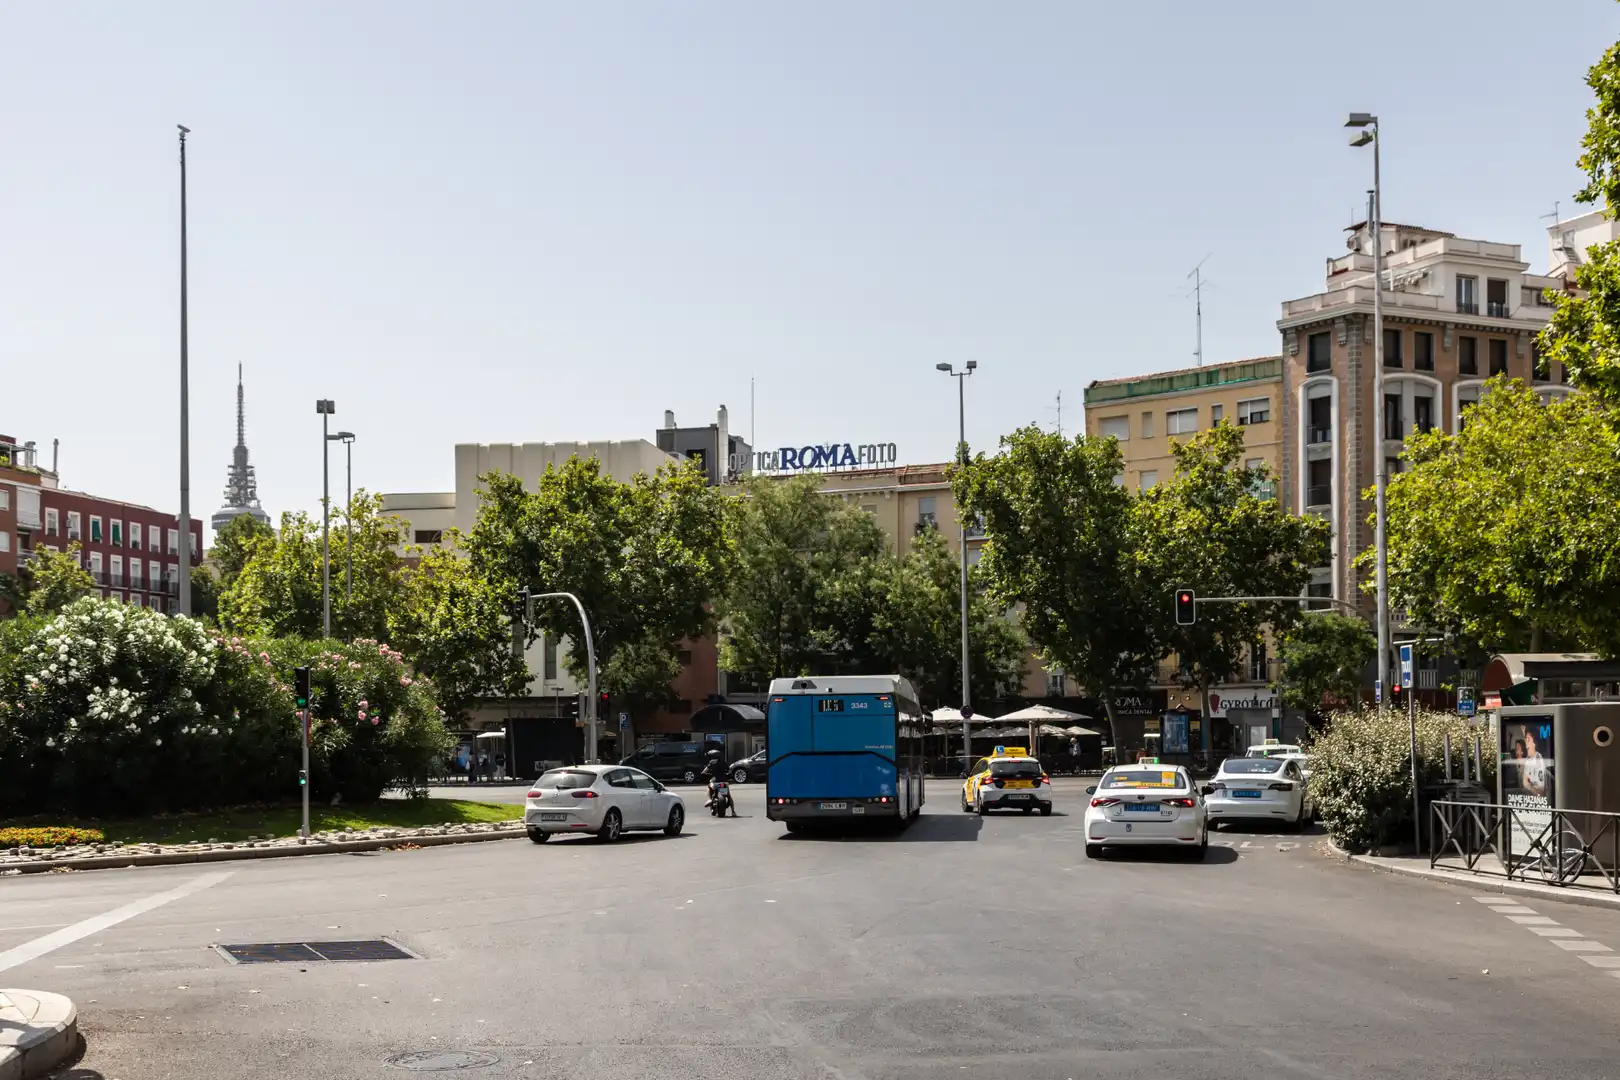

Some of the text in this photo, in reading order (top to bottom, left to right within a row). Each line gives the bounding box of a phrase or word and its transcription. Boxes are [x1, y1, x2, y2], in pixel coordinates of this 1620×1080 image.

[779, 443, 858, 470] ROMA
[858, 442, 897, 465] FOTO
[621, 714, 627, 724] P
[1508, 793, 1548, 805] DAME HAZAÑAS
